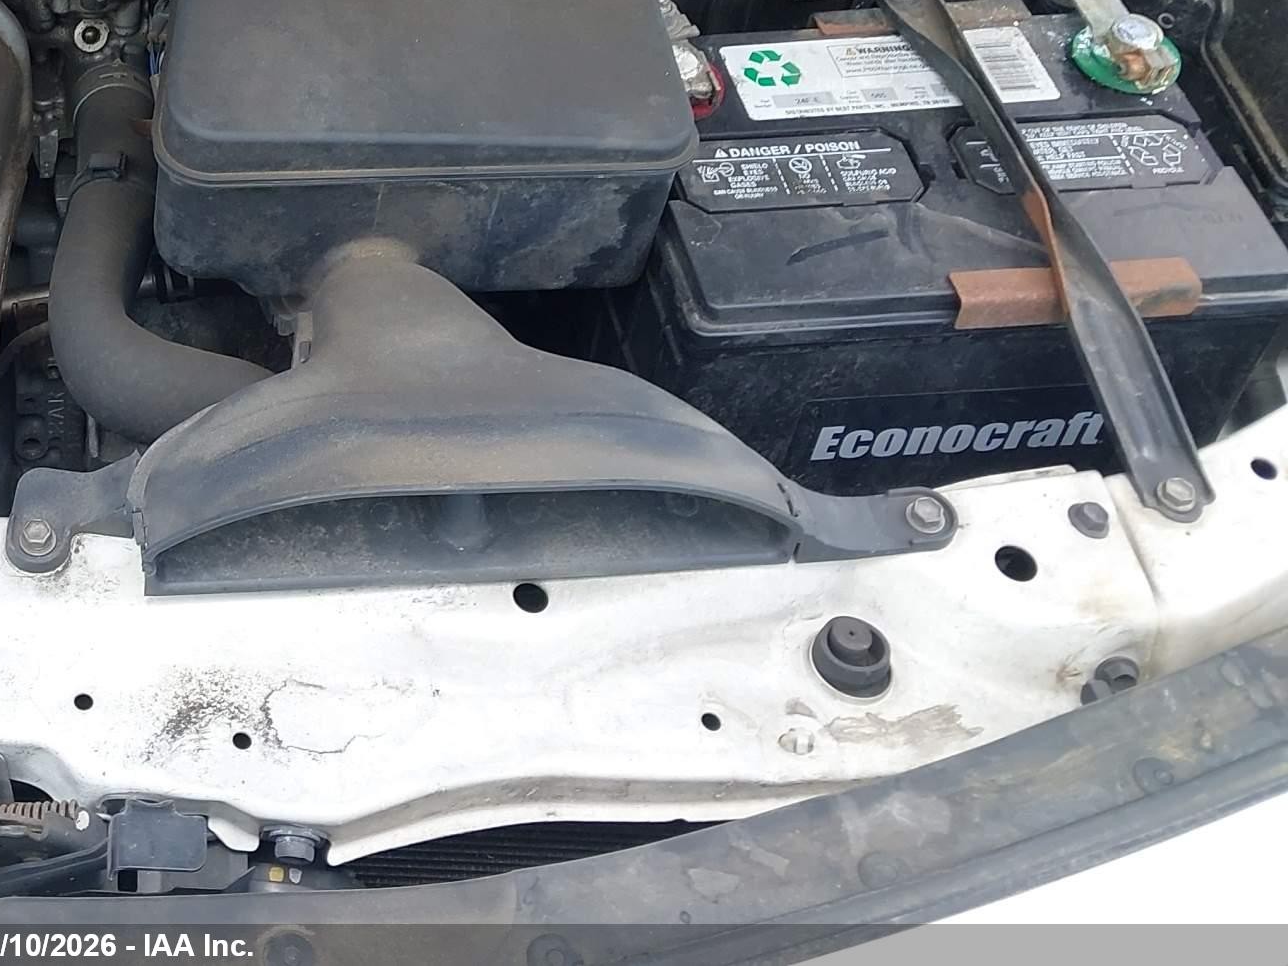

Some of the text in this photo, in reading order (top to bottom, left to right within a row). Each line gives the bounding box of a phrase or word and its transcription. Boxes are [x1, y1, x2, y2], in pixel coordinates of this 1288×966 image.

[729, 141, 860, 158] DANGER / POISON
[810, 411, 1104, 461] Econocraft
